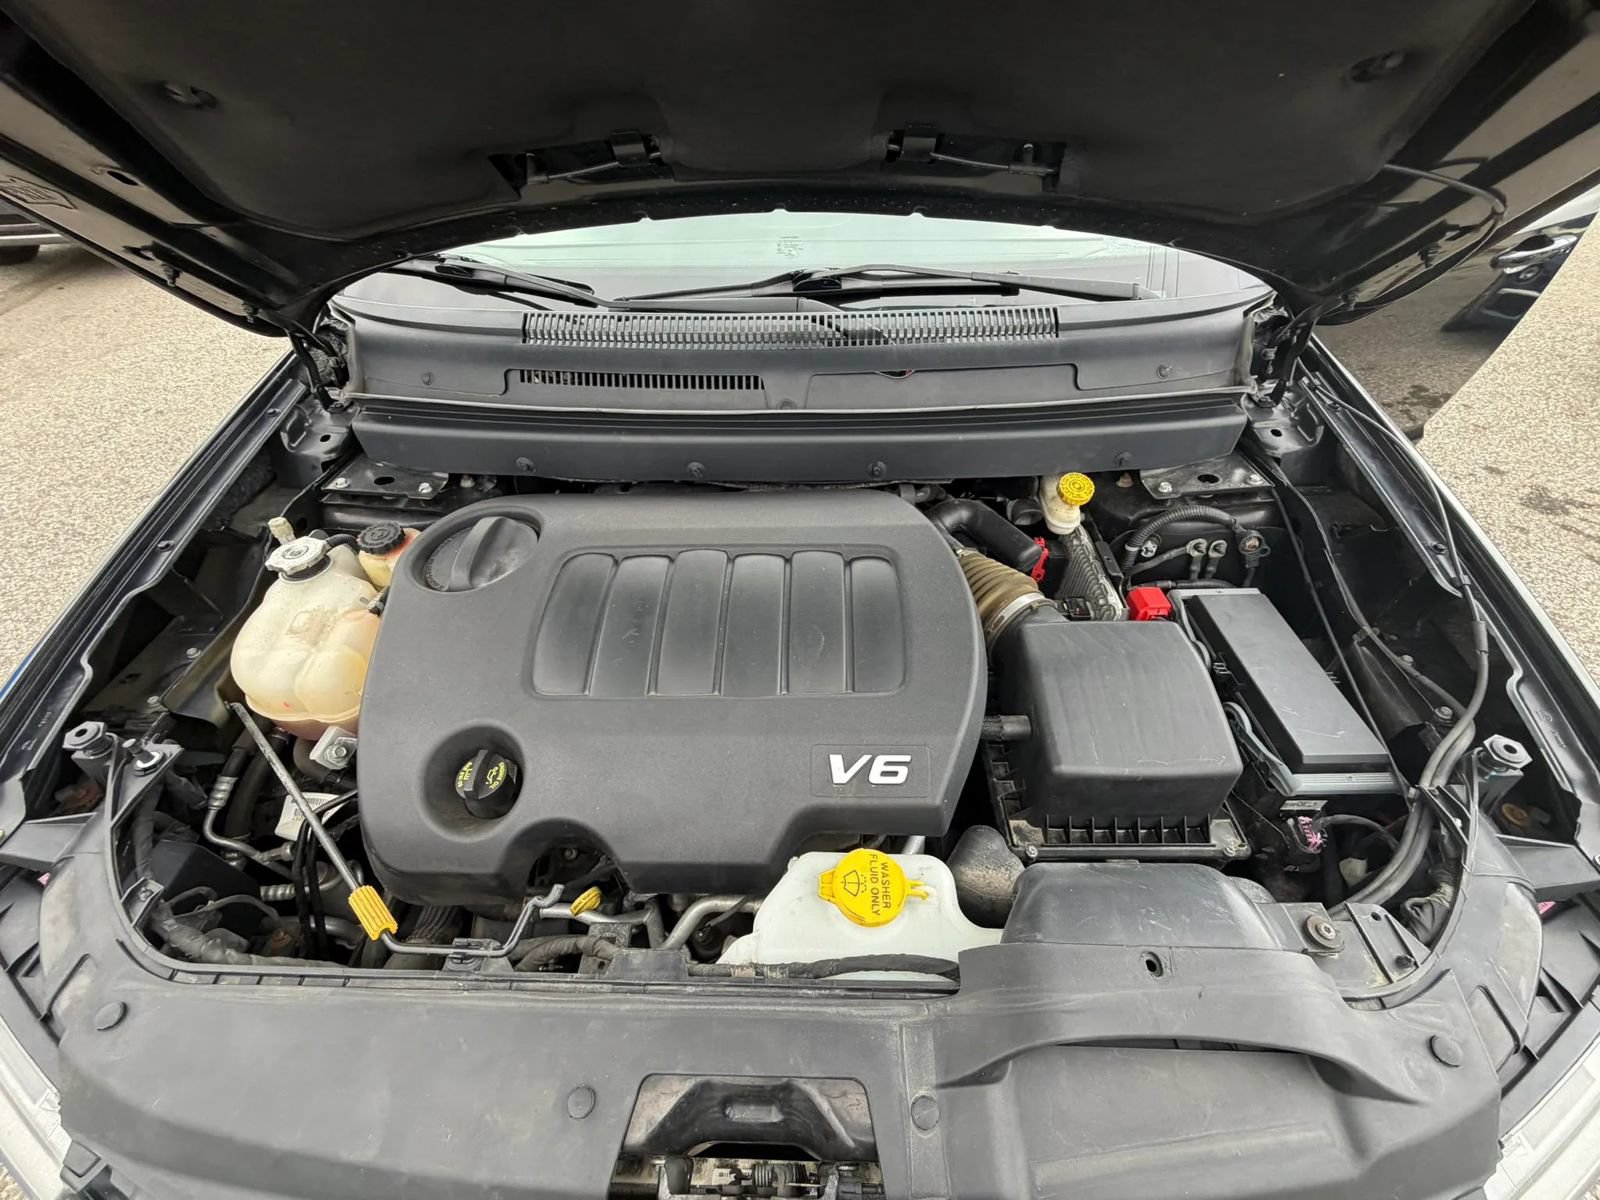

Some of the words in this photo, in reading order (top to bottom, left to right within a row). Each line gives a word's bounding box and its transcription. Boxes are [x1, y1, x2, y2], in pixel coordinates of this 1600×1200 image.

[829, 754, 912, 785] V6
[869, 853, 879, 885] FLUID
[880, 862, 892, 909] WASHER
[870, 887, 881, 916] ONLY
